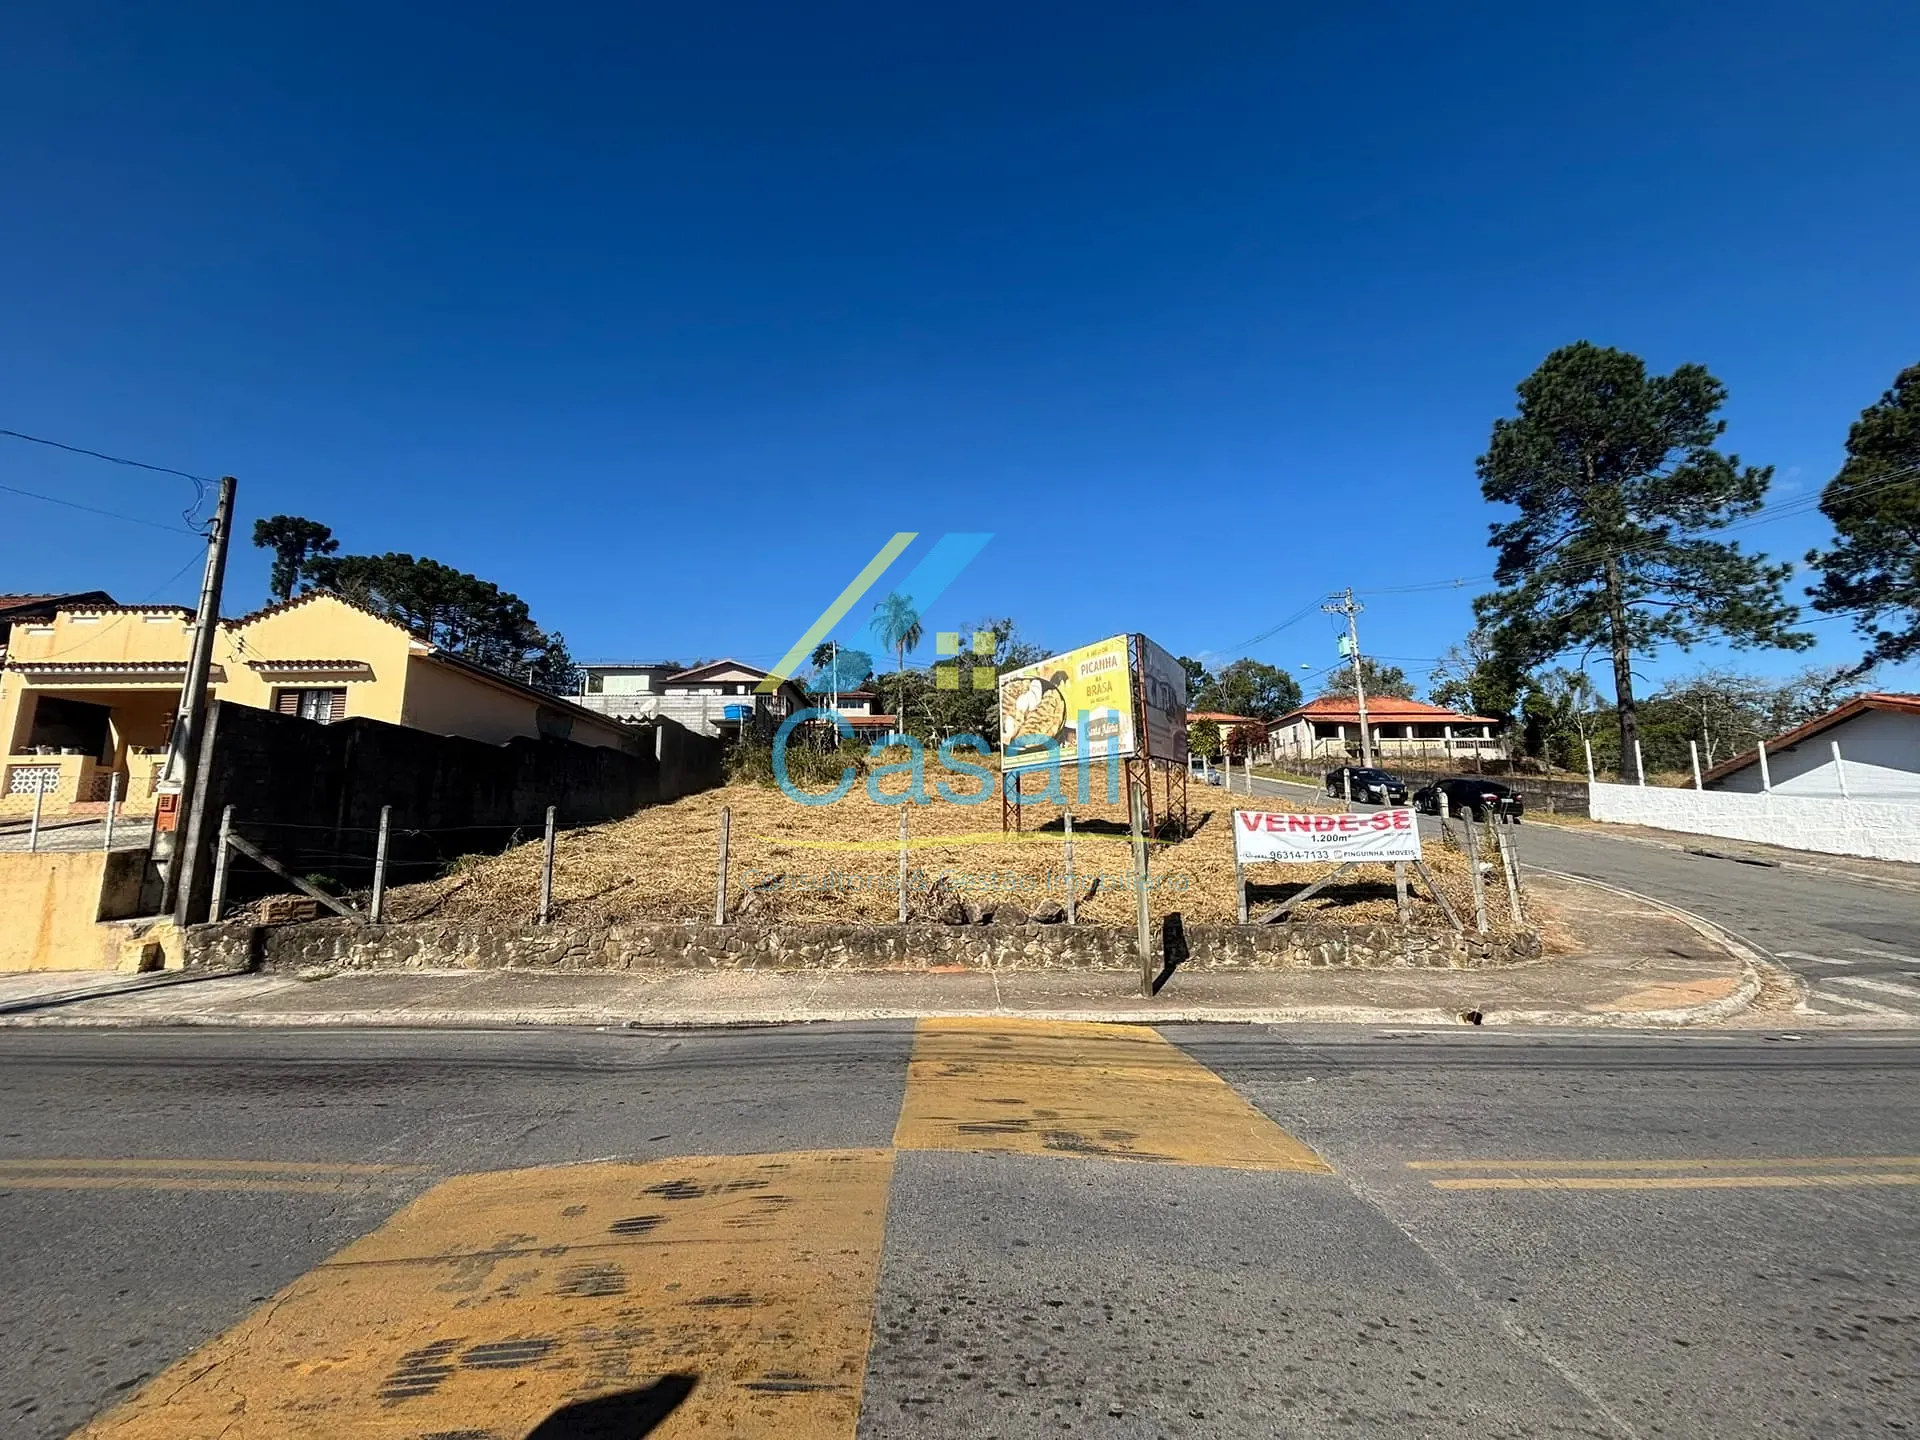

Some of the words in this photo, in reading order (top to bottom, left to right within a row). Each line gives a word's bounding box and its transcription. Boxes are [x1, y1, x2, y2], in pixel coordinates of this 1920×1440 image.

[1081, 655, 1118, 676] PICANHA
[1086, 681, 1113, 697] BRASA
[1240, 811, 1411, 833] VENDE-SE
[1270, 850, 1329, 860] 96314-7133
